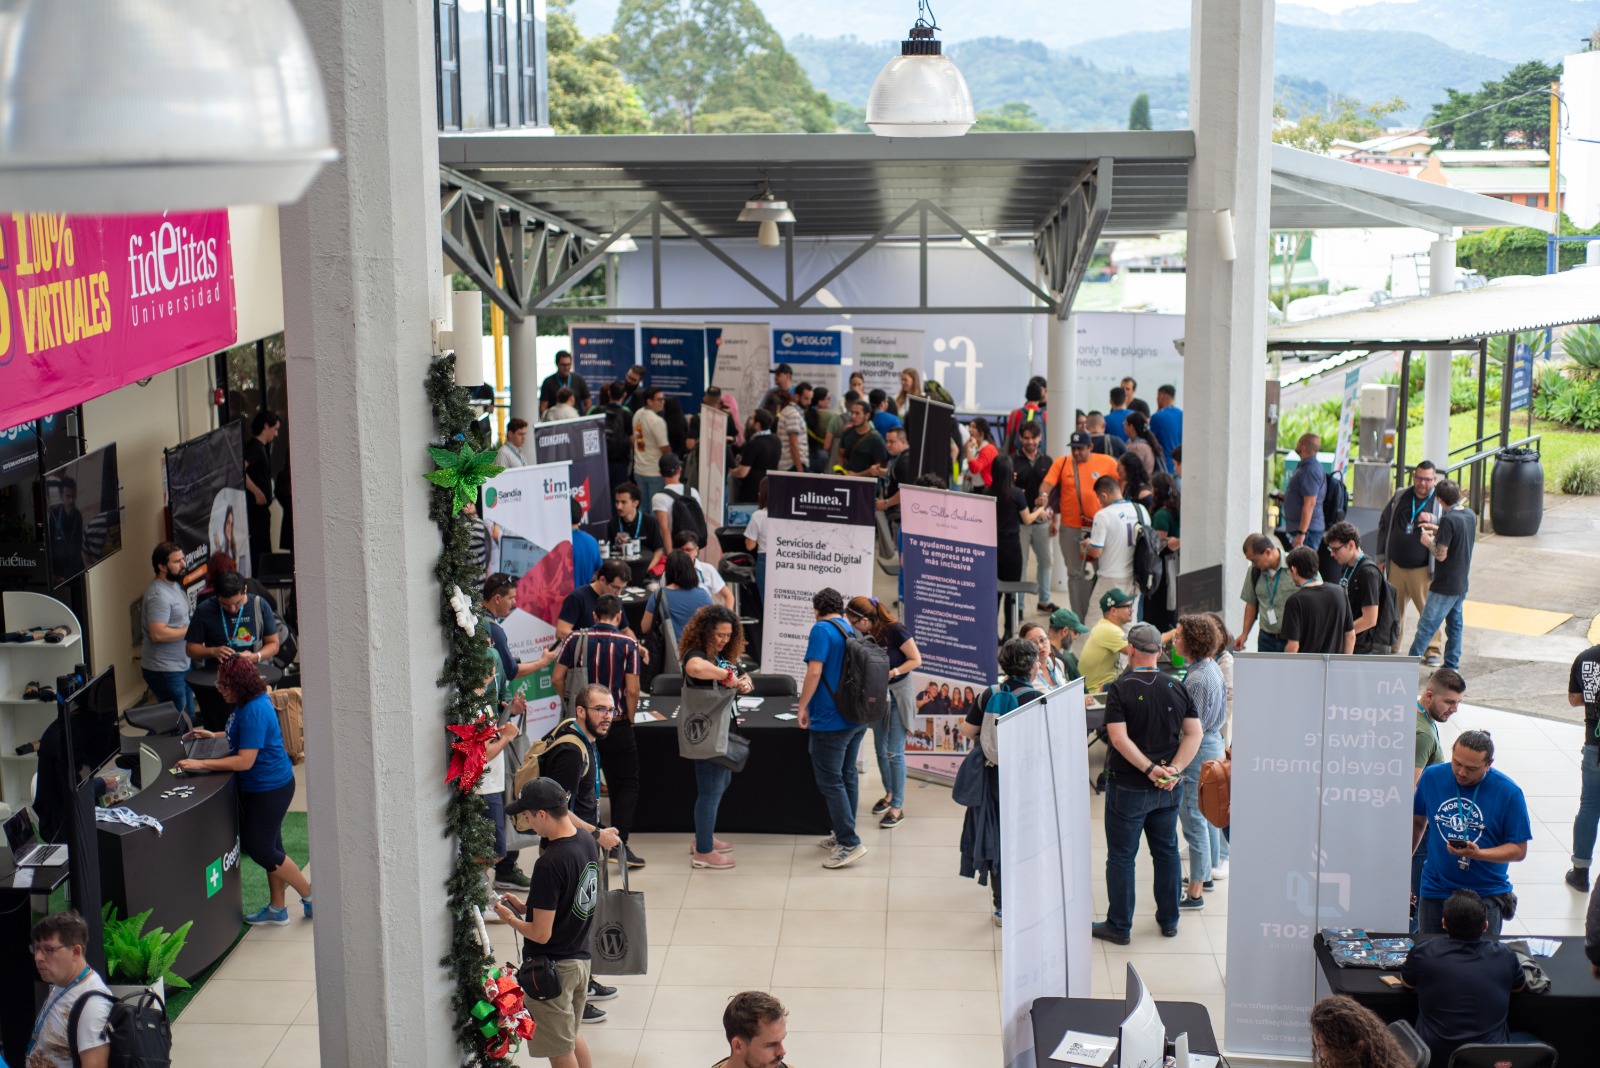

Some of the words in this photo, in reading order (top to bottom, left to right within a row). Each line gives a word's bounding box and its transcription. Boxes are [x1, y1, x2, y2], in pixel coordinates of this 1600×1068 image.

[131, 282, 221, 327] Universidad
[17, 271, 111, 354] VIRTUALES
[796, 335, 834, 346] WEGLOT
[1078, 345, 1100, 356] only
[1102, 346, 1119, 355] the
[1121, 346, 1158, 358] plugins
[859, 359, 895, 371] Hosting
[1076, 358, 1102, 367] need
[543, 478, 567, 494] tim
[498, 488, 522, 499] Sandía
[543, 492, 568, 501] learning
[799, 491, 843, 506] alinea.
[776, 536, 814, 549] Servicios
[815, 540, 827, 550] de
[919, 541, 953, 551] ayudamos
[955, 546, 971, 554] para
[973, 549, 986, 557] que
[776, 548, 832, 562] Accesibilidad
[834, 553, 862, 566] Digital
[931, 551, 960, 561] empresa
[962, 555, 974, 563] sea
[775, 561, 795, 570] para
[808, 564, 842, 574] negocio
[925, 557, 939, 565] más
[940, 560, 971, 571] inclusiva
[922, 608, 952, 618] CAPACITACIÓN
[952, 614, 976, 622] INCLUSIVA
[534, 635, 555, 644] SABOR
[520, 647, 542, 657] MARCA
[1442, 802, 1479, 818] WORCAMP
